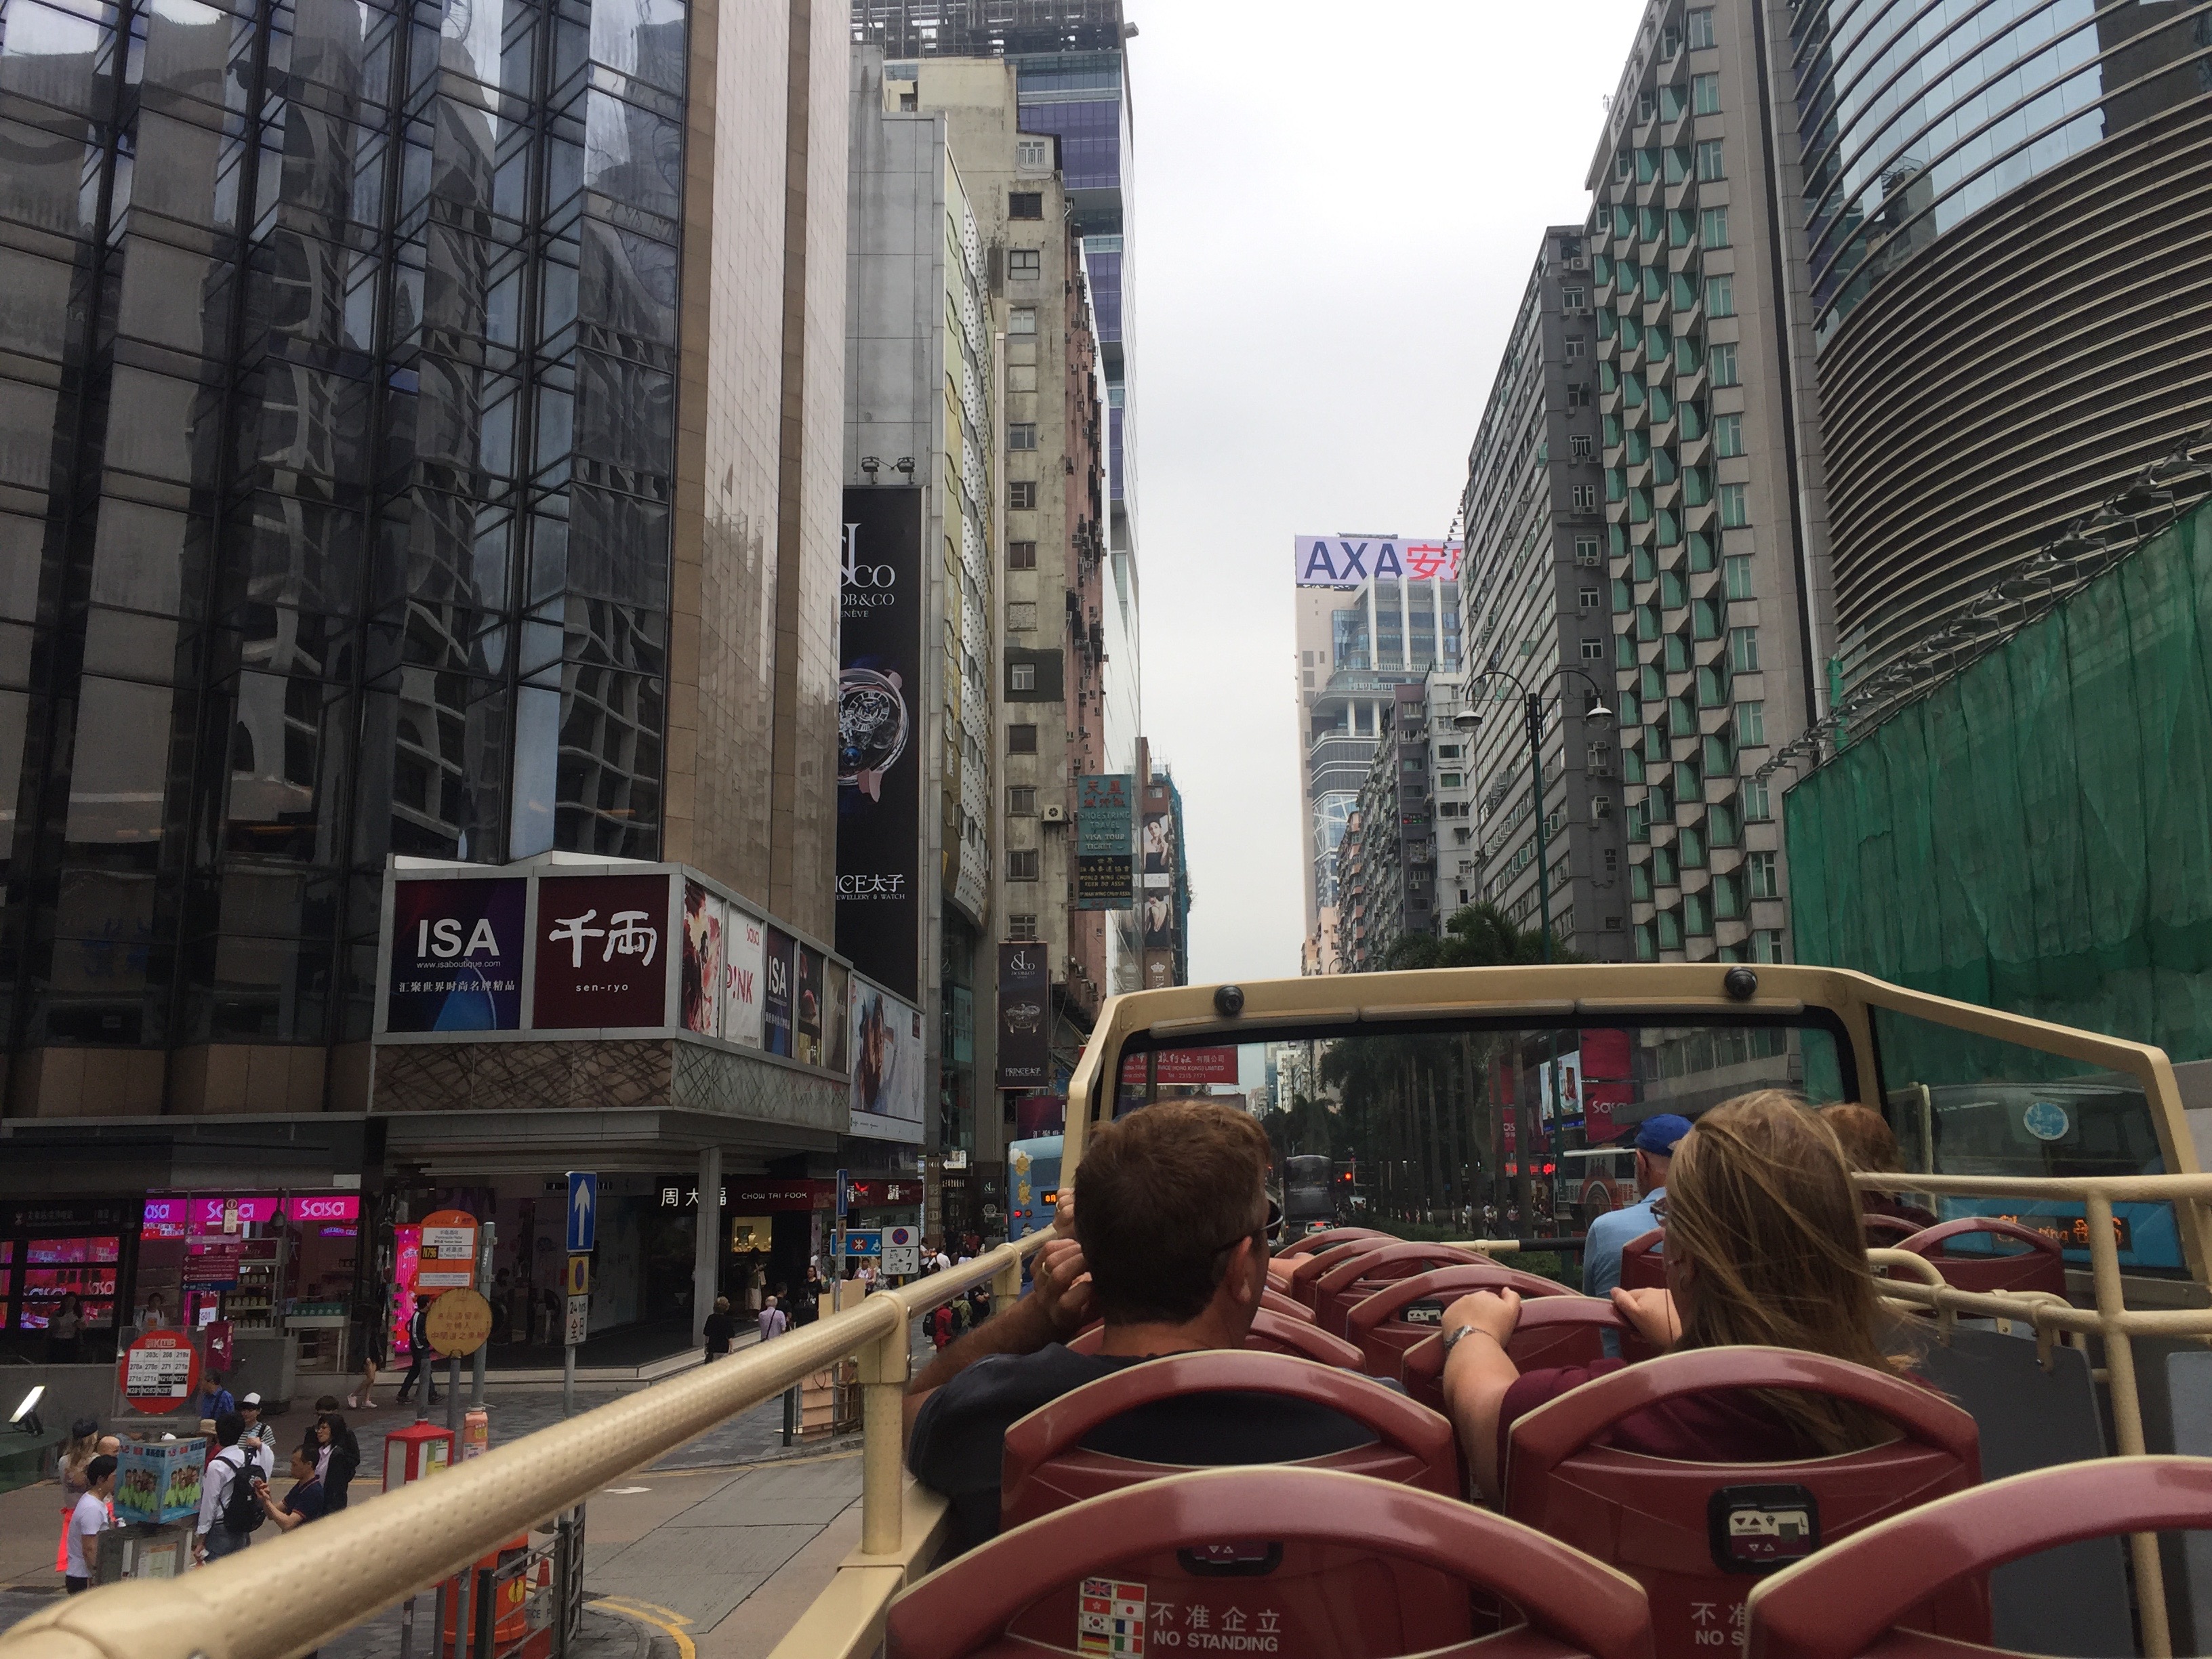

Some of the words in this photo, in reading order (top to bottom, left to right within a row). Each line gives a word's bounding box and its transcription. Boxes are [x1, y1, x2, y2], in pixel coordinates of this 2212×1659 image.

[1304, 541, 1402, 579] AXA
[841, 594, 895, 607] OB&CO
[841, 609, 869, 617] ENÈVE
[1080, 811, 1130, 819] SHOESTRING
[836, 874, 905, 893] CE太子
[417, 918, 500, 958] ISA
[416, 960, 501, 968] www.isaboutique.com
[769, 956, 787, 998] ISA
[398, 981, 515, 993] 汇聚世界时尚名牌精品
[575, 983, 629, 992] sen-ryo
[1197, 1055, 1224, 1063] 有限公司
[144, 1204, 169, 1218] asa
[206, 1201, 254, 1218] Saa
[300, 1200, 345, 1218] Sasa
[422, 1248, 437, 1258] N796
[905, 1249, 912, 1257] 7
[906, 1263, 912, 1271] 7
[570, 1302, 577, 1314] 24
[571, 1317, 583, 1339] 全日
[1150, 1602, 1281, 1633] 不准企立
[1153, 1631, 1181, 1646] NO
[1187, 1632, 1278, 1652] STANDING
[1696, 1631, 1723, 1645] NO
